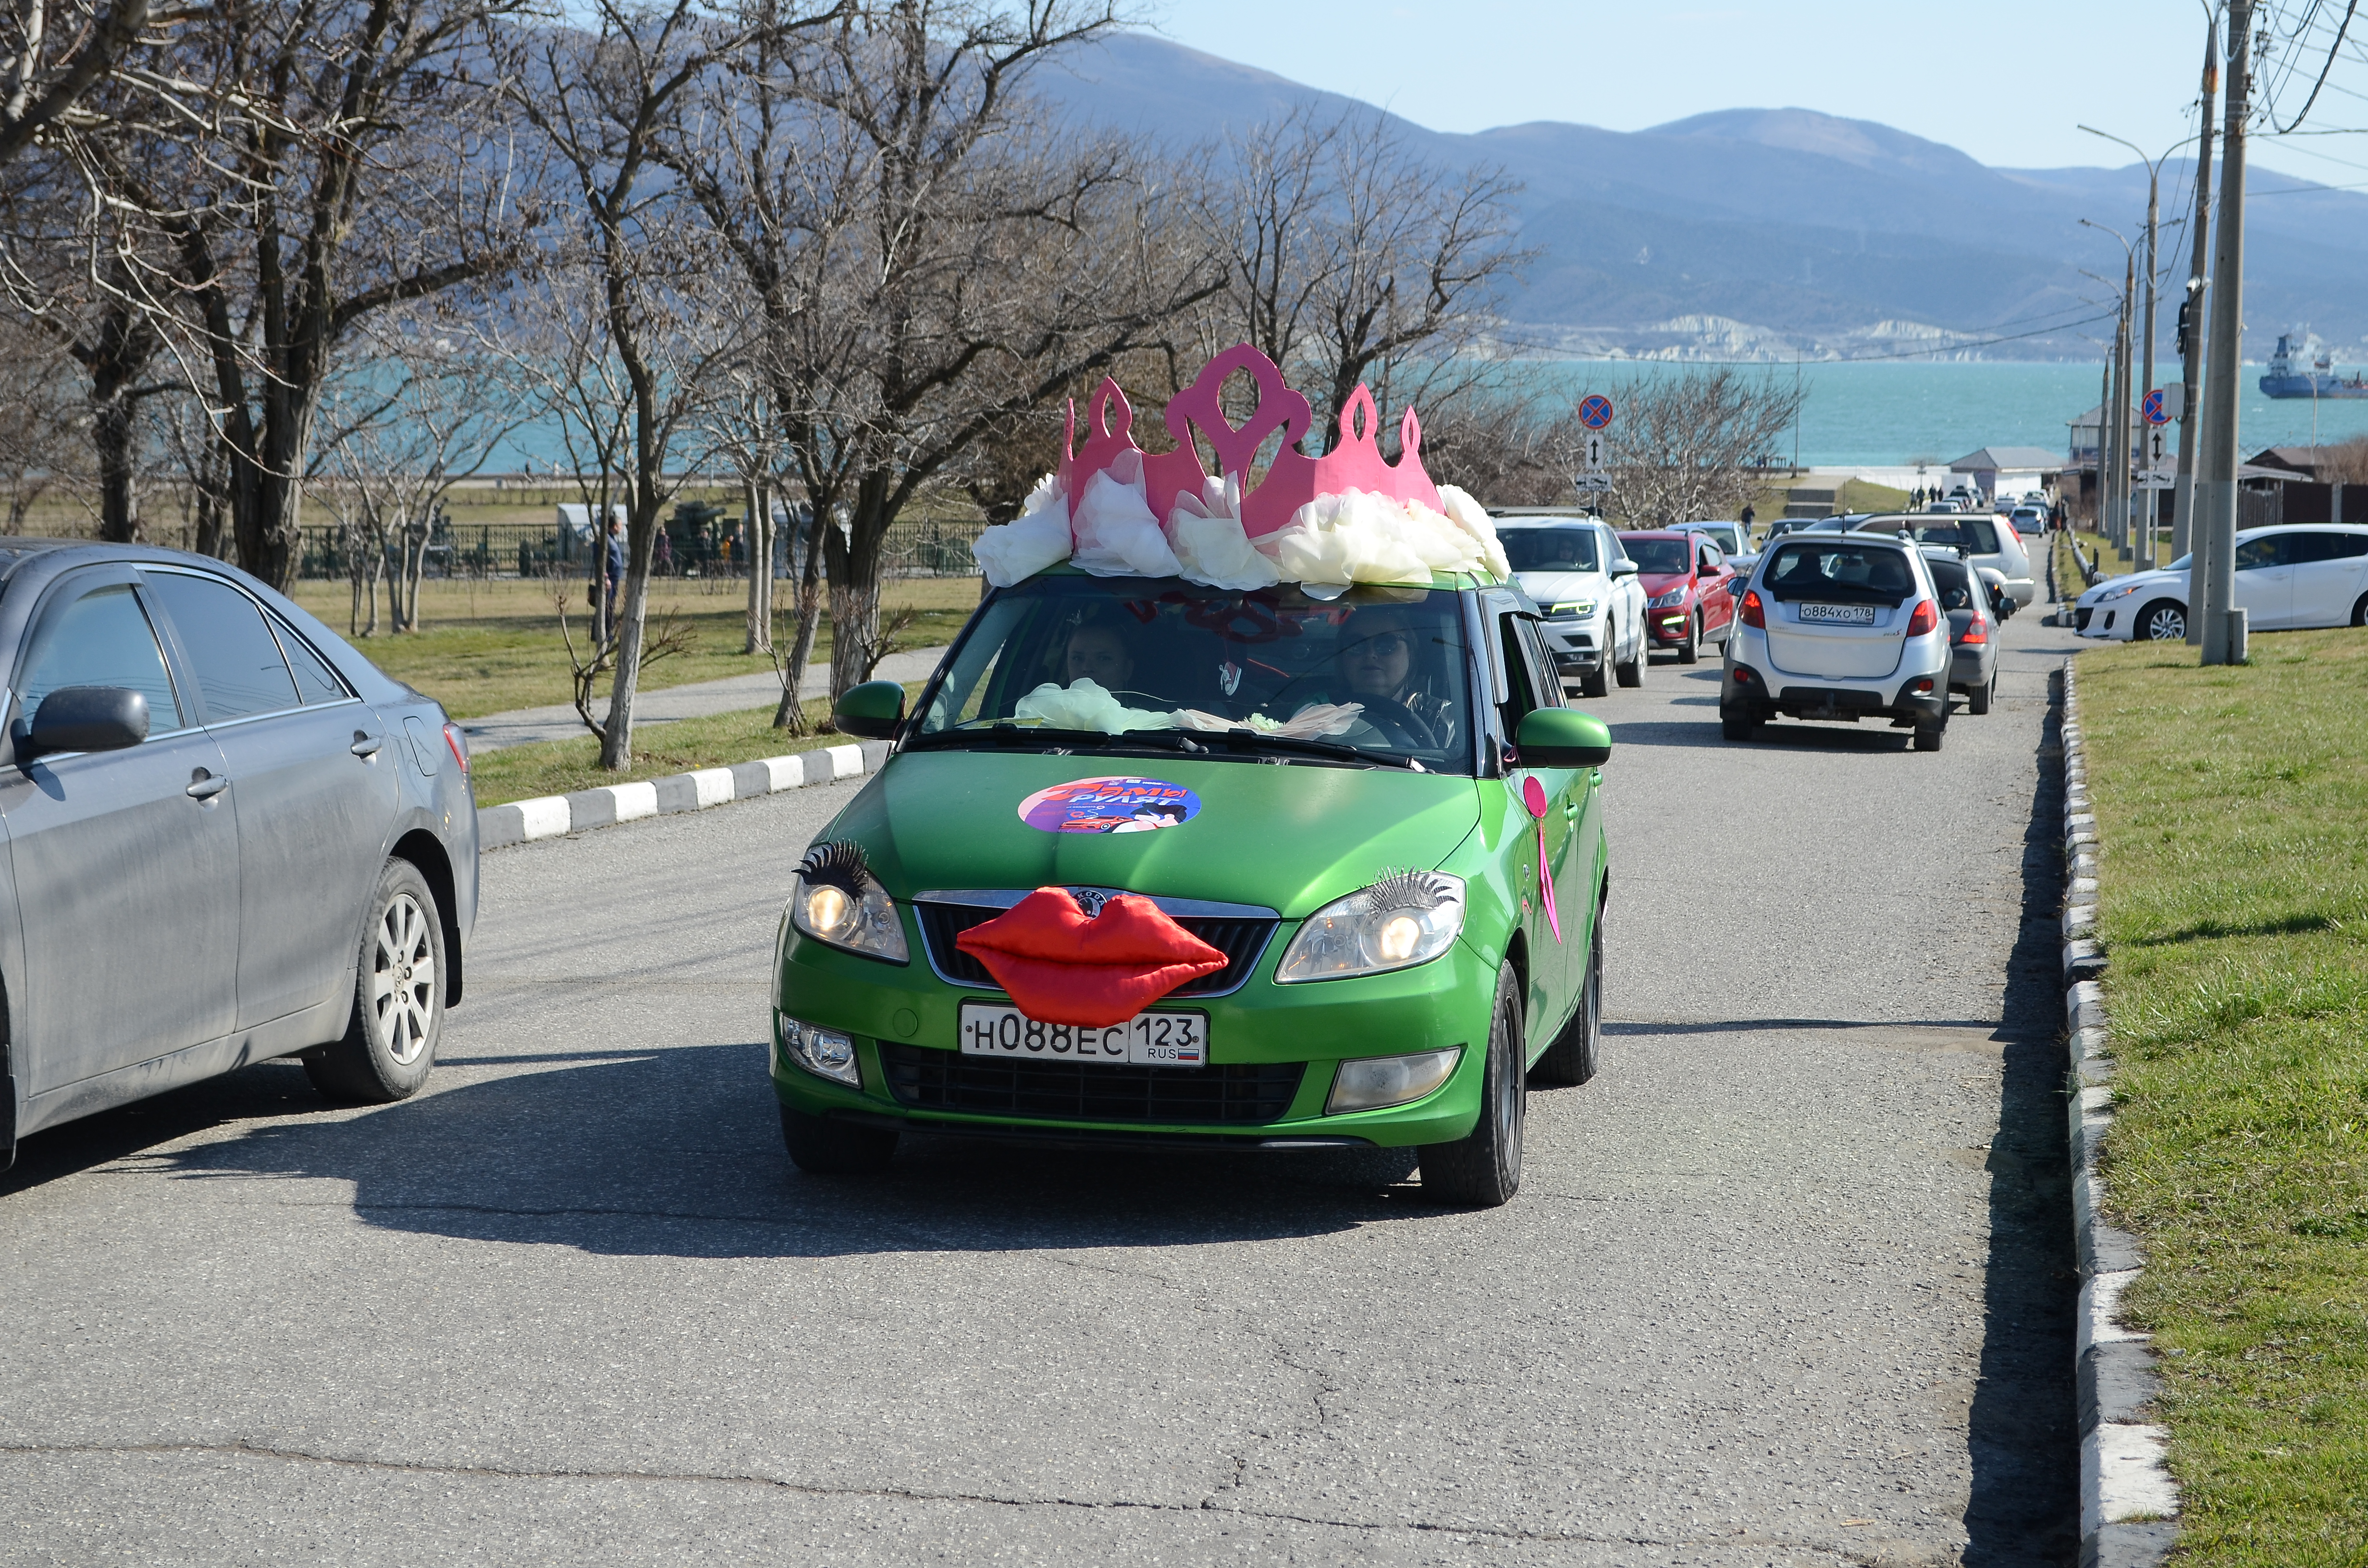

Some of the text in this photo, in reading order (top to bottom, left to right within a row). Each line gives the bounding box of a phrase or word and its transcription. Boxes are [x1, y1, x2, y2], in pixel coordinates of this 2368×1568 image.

[1854, 607, 1870, 617] 178
[1069, 794, 1180, 806] РУЛЯТ
[1077, 891, 1105, 906] KODA
[1135, 1017, 1193, 1047] 123
[1147, 1048, 1176, 1060] RUS
